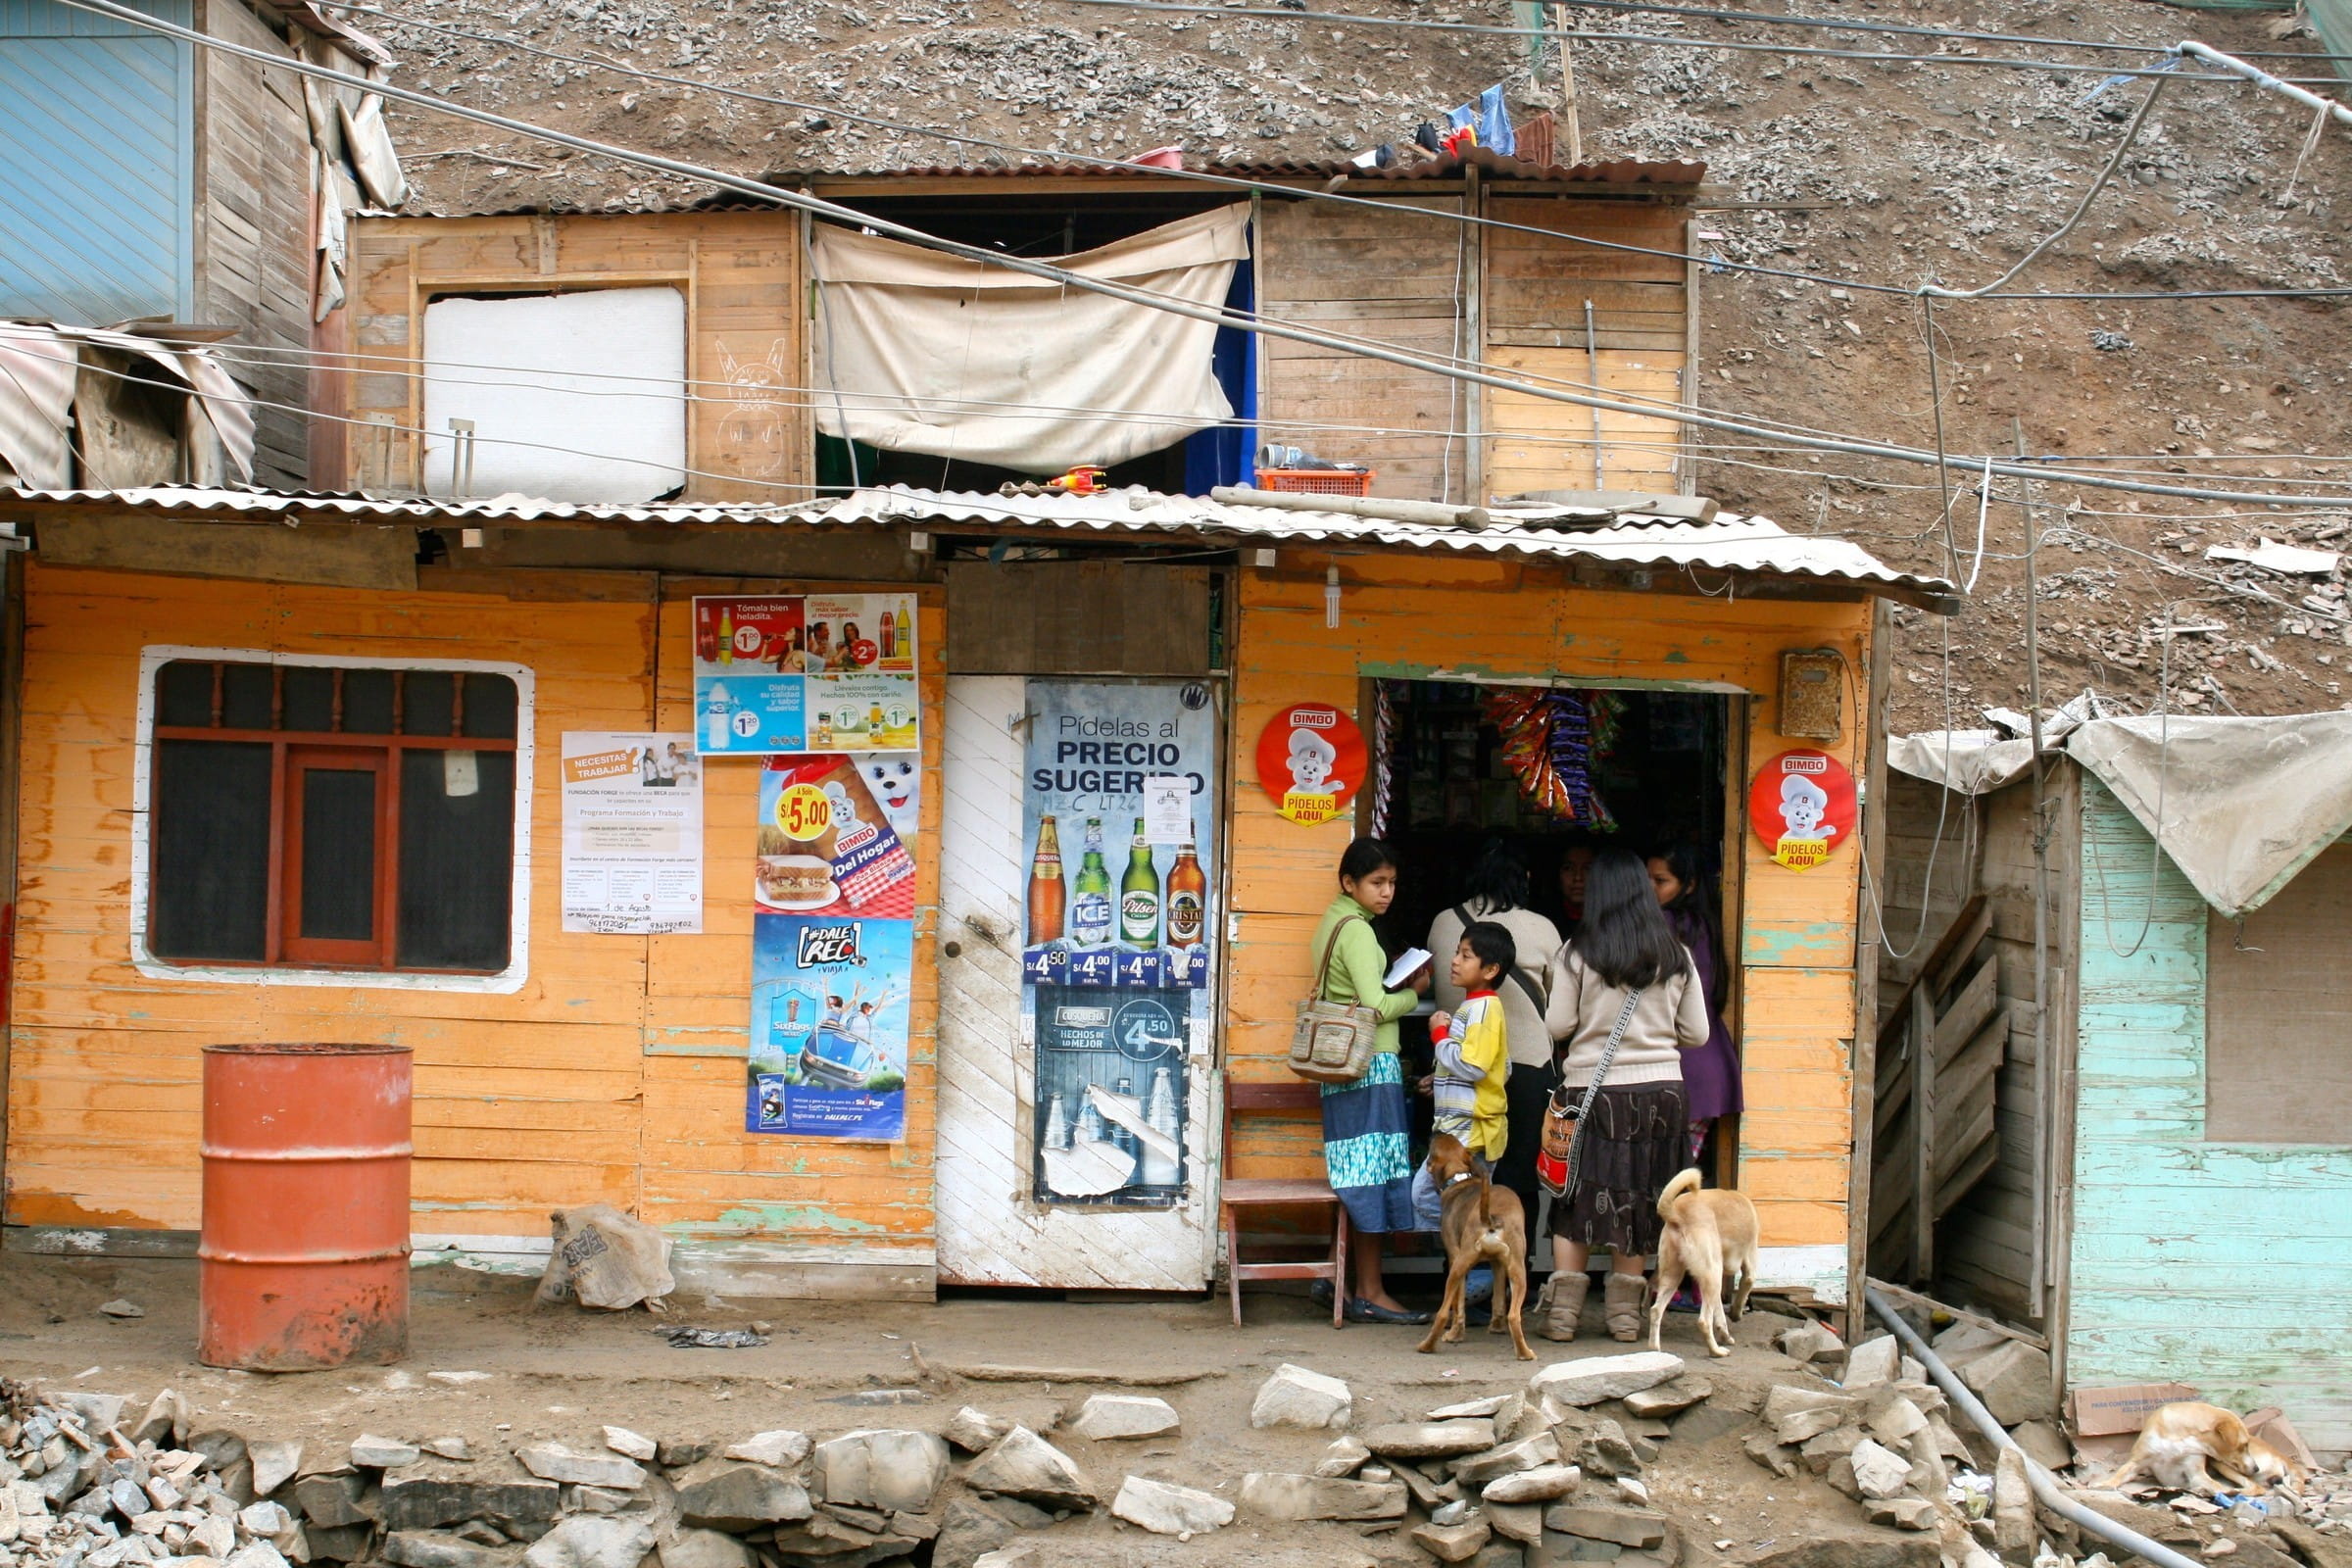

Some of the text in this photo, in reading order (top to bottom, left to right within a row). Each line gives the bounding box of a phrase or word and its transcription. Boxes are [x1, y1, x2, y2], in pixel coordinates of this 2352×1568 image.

[736, 604, 789, 612] Tómala bien
[1059, 715, 1179, 738] Pídelas al
[1294, 714, 1334, 725] BIMBO
[574, 753, 627, 768] NECESITAS
[1056, 741, 1180, 766] PRECIO
[576, 763, 628, 778] TRABAJAR
[1785, 760, 1824, 770] BIMBO
[1032, 768, 1205, 795] SUGERO
[1288, 797, 1333, 810] PÍDELOS
[658, 809, 684, 818] Trabajo
[837, 827, 875, 853] BIMBO
[834, 834, 896, 877] Del Hogar
[1781, 842, 1825, 856] PÍDELOS
[613, 904, 624, 912] de
[1123, 898, 1158, 914] Pilsen
[1075, 905, 1110, 923] ICE
[805, 938, 853, 962] REC
[1061, 1010, 1106, 1022] CUSQUEÑA
[1060, 1029, 1095, 1039] HECHOS
[1071, 1039, 1103, 1049] MEJOR
